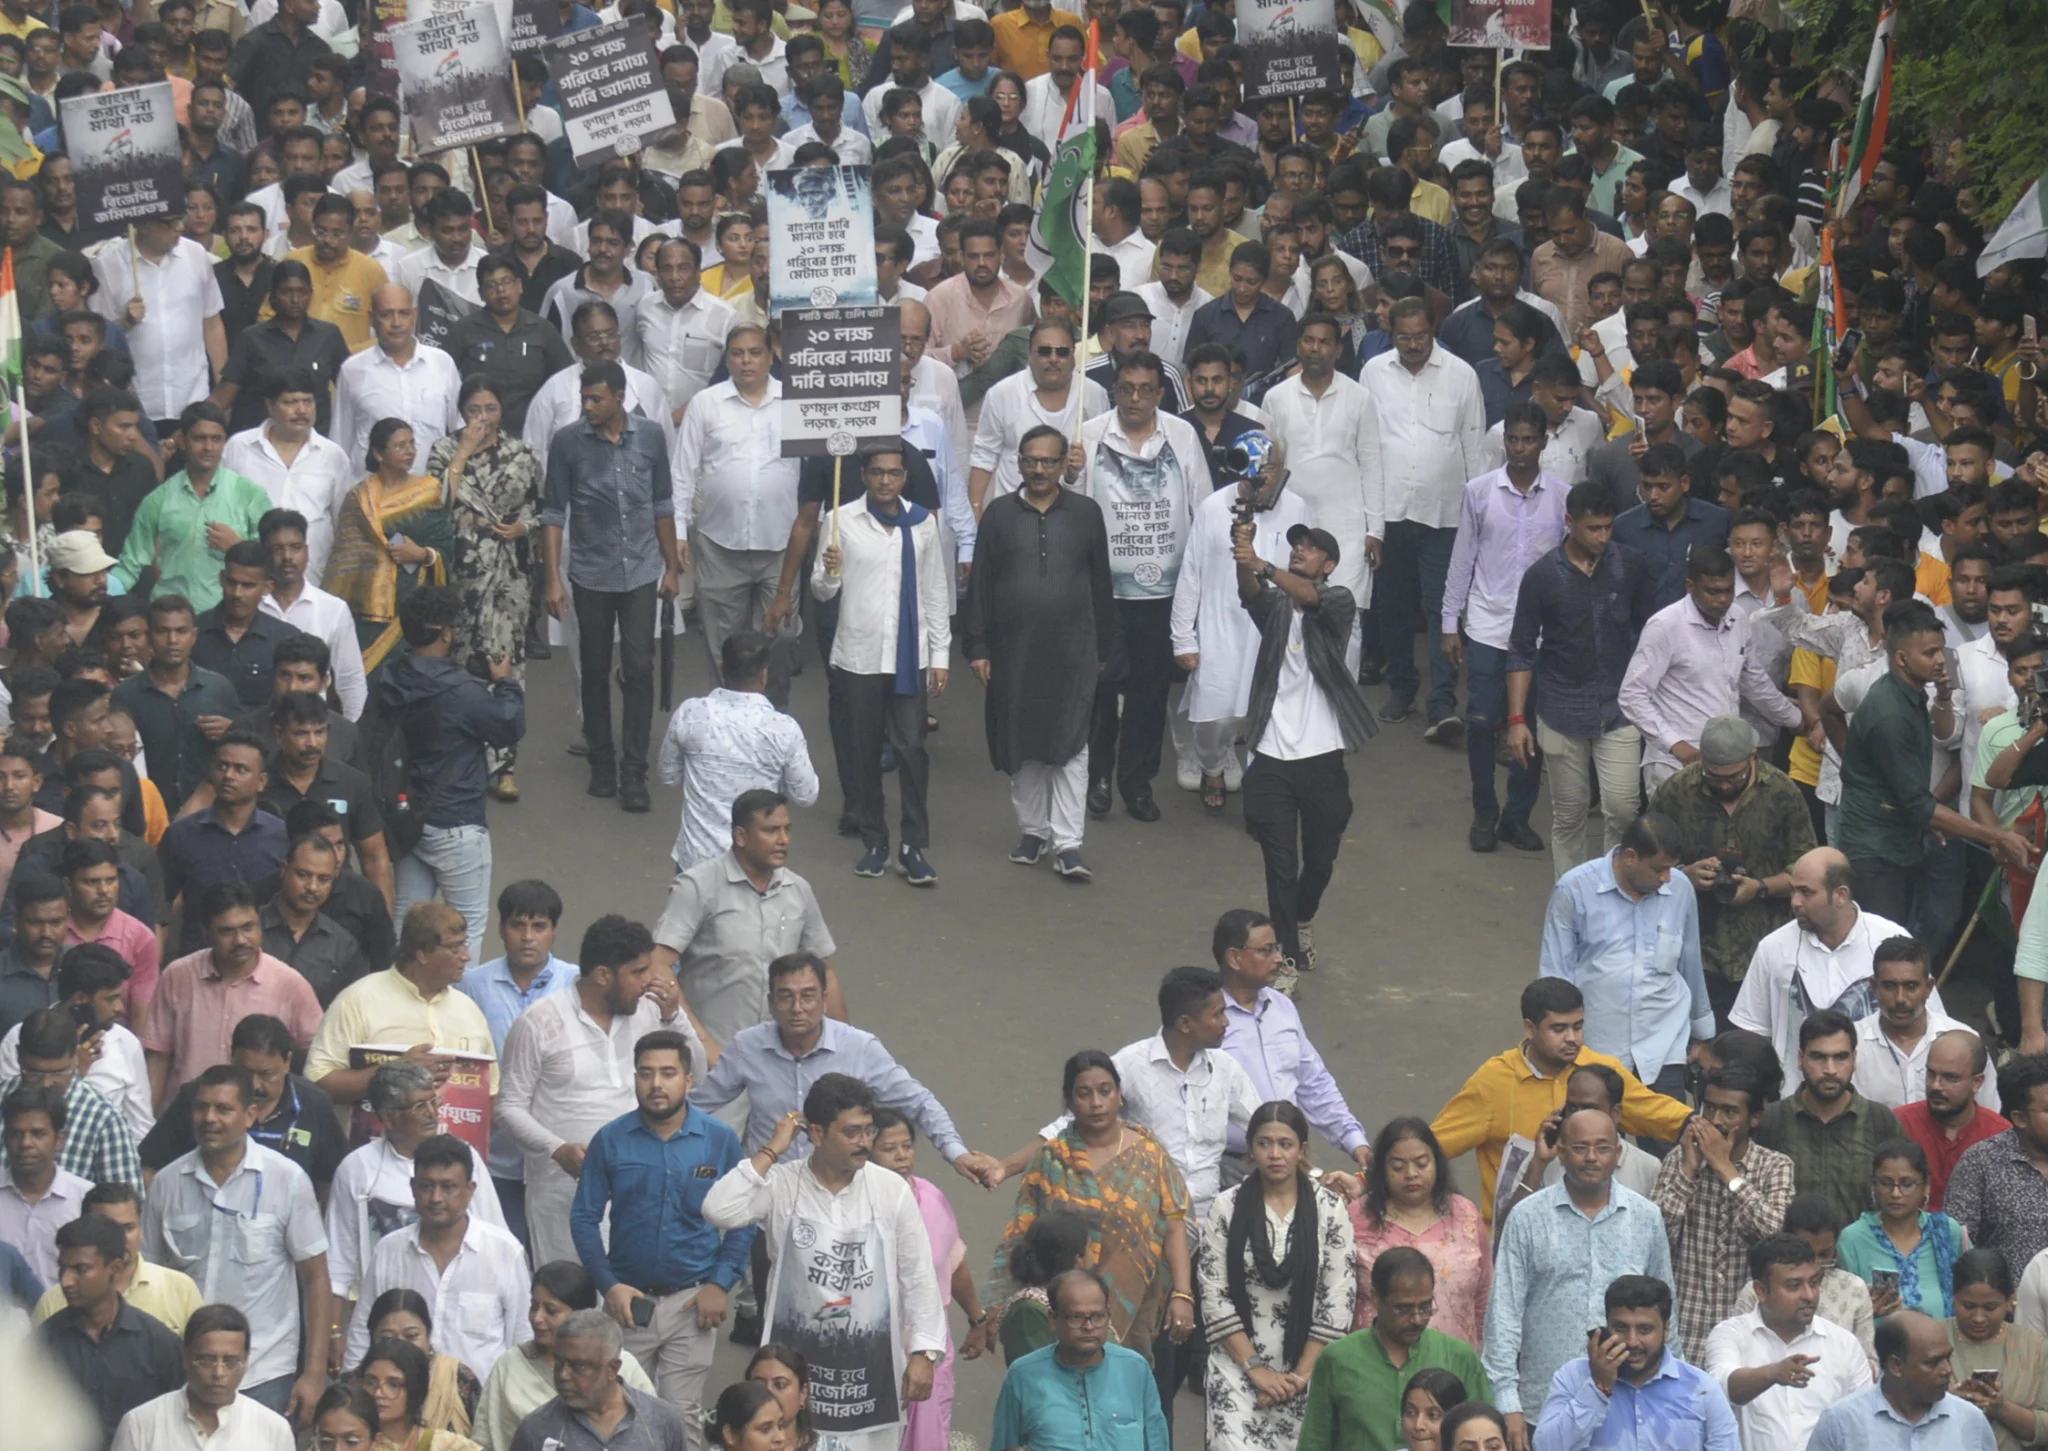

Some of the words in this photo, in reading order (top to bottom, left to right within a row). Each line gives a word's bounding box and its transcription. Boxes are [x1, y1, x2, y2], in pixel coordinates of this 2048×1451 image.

[423, 10, 465, 29] বাংলা
[416, 24, 457, 42] করবে
[460, 19, 477, 31] না
[417, 37, 453, 55] মাথা
[455, 31, 480, 45] নত
[569, 51, 590, 66] ২০
[590, 37, 627, 58] লক্ষ
[559, 63, 610, 90] গরিবের
[611, 52, 649, 73] ন্যায্য
[1268, 58, 1291, 70] শেষ
[1294, 55, 1313, 66] হবে
[1266, 66, 1317, 82] বিজেপির
[567, 86, 598, 109] দাবি
[598, 72, 652, 98] আদায়ে
[1258, 77, 1327, 95] জমিদারতন্ত্র
[95, 90, 141, 106] বাংলা
[88, 102, 130, 119] করবে
[134, 99, 152, 112] না
[440, 104, 465, 119] শেষ
[466, 100, 487, 112] হবে
[582, 111, 617, 130] তৃণমূল
[617, 99, 652, 117] কংগ্রেস
[88, 115, 125, 132] মাথা
[129, 112, 154, 125] নত
[439, 111, 493, 133] বিজেপির
[624, 113, 653, 130] লড়বে
[432, 121, 504, 147] জমিদারতন্ত্র
[104, 183, 130, 196] শেষ
[132, 179, 154, 190] হবে
[102, 190, 159, 209] বিজেপির
[94, 201, 169, 223] জমিদারতন্ত্র
[787, 222, 825, 233] বাংলার
[828, 217, 850, 230] দাবি
[791, 231, 825, 242] মানতে
[828, 230, 846, 240] হবে
[800, 246, 815, 255] ২০
[819, 243, 845, 254] লক্ষ
[787, 255, 828, 268] গরিবের
[830, 254, 857, 266] প্রাপ্য
[789, 267, 829, 280] মেটাতে
[807, 329, 830, 344] ২০
[833, 327, 875, 342] লক্ষ
[789, 347, 848, 367] গরিবের
[850, 348, 893, 364] ন্যায্য
[791, 370, 826, 389] দাবি
[828, 371, 890, 388] আদায়ে
[799, 403, 838, 417] তৃণমূল
[840, 400, 881, 412] কংগ্রেস
[844, 416, 877, 429] লড়বে
[1111, 501, 1152, 511] বাংলার
[1115, 511, 1151, 521] মানতে
[1154, 509, 1170, 520] হবে
[1124, 523, 1140, 533] ২০
[1144, 521, 1170, 532] লক্ষ
[1110, 532, 1153, 546] গরিবের
[1112, 545, 1155, 557] মেটাতে
[447, 1072, 484, 1087] গুনে
[808, 1266, 850, 1292] মাথা
[852, 1270, 874, 1291] নত
[840, 1367, 867, 1382] হবে
